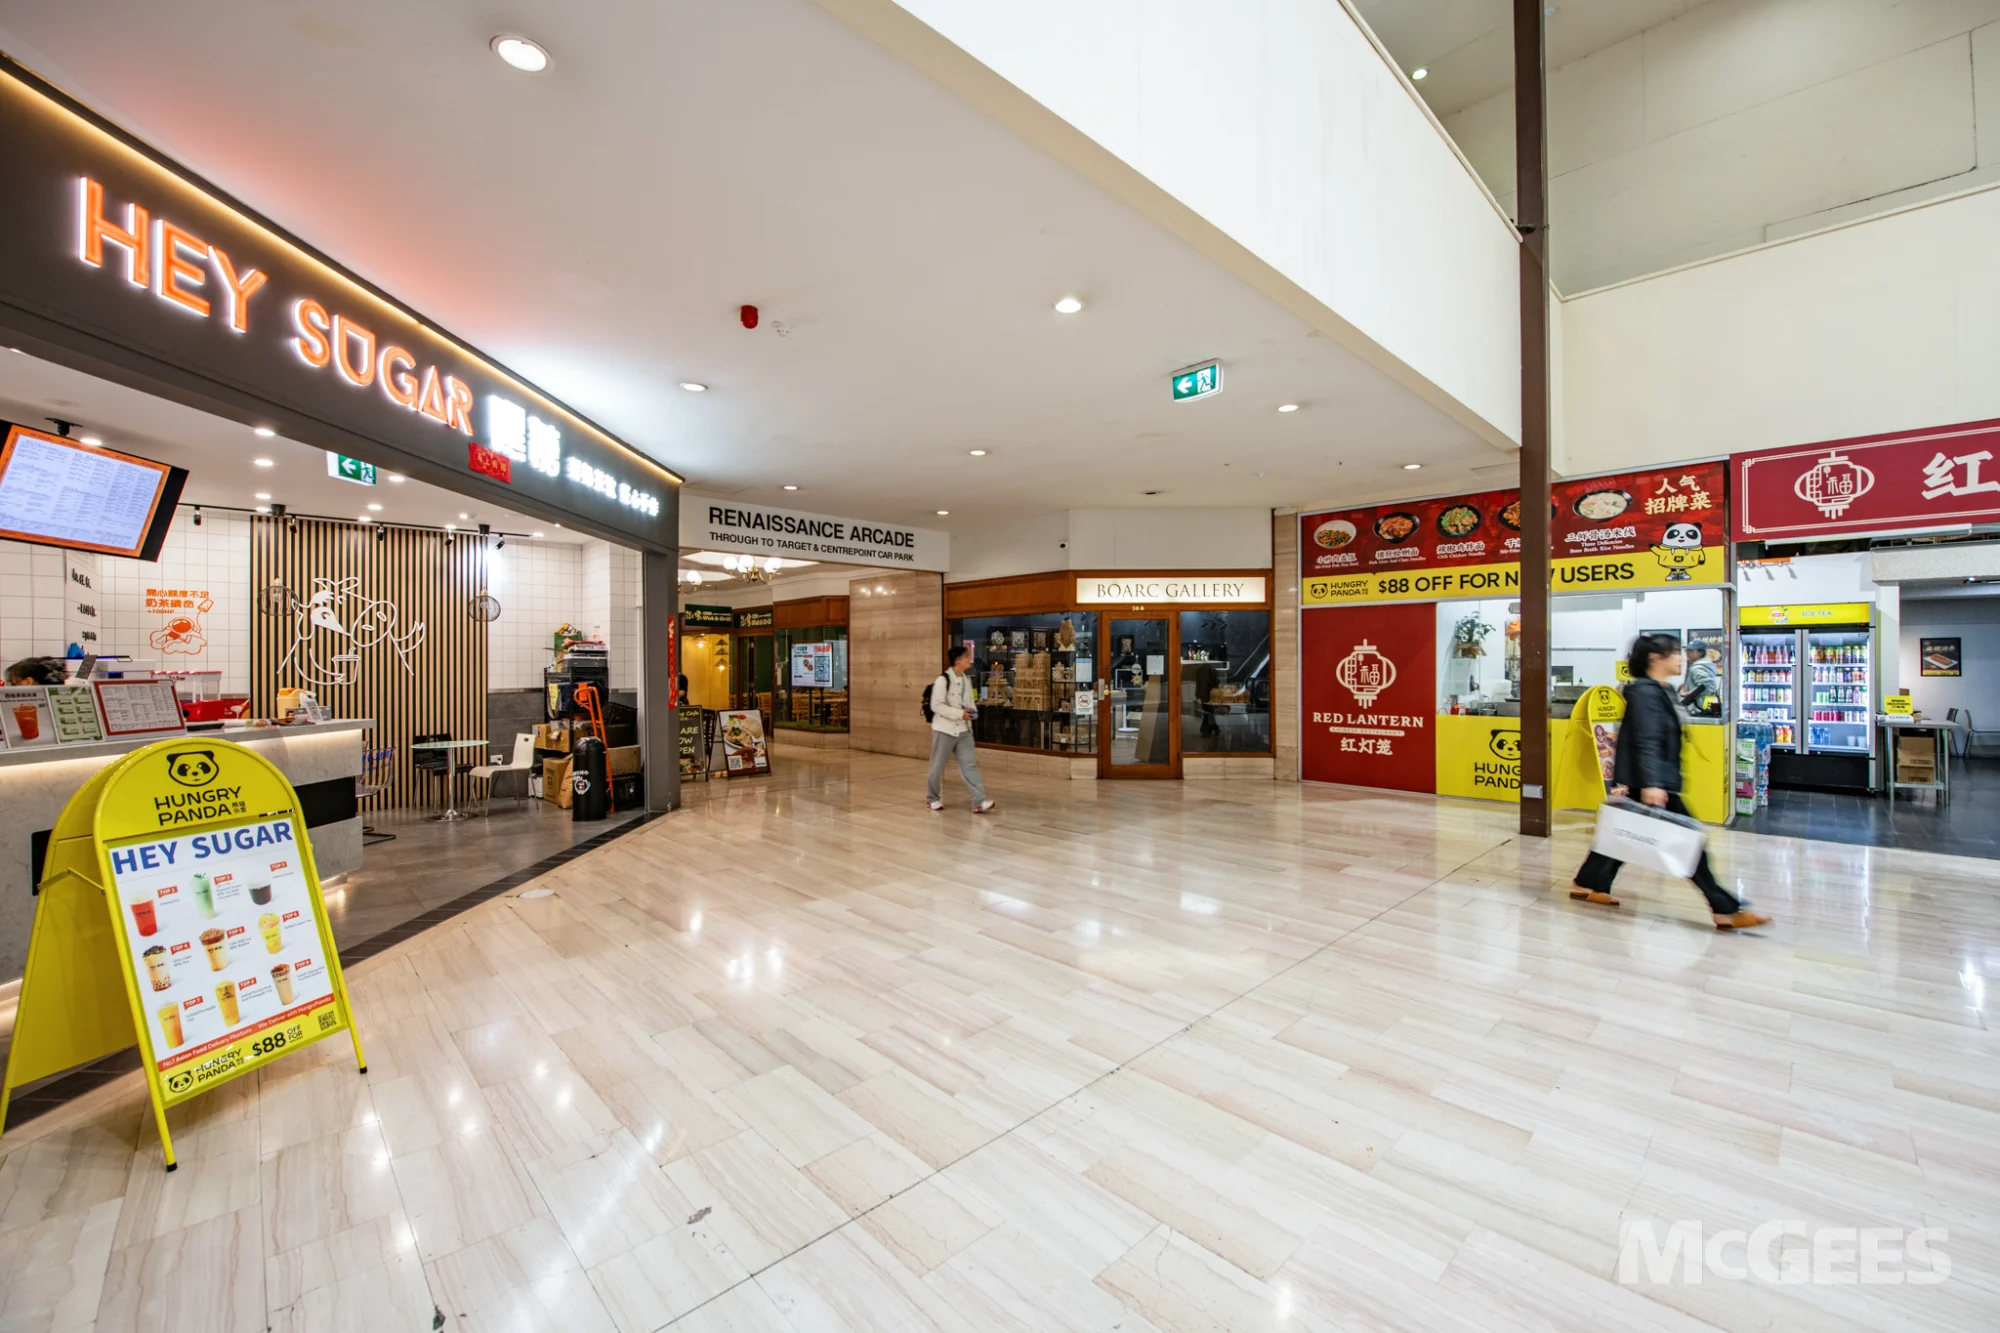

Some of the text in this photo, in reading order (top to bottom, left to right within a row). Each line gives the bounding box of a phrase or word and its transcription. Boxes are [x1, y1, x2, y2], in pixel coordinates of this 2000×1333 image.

[79, 177, 268, 333] HEY
[291, 298, 475, 436] SUGAR
[1655, 475, 1701, 494] 人气
[1921, 450, 2000, 500] 红
[1644, 491, 1713, 515] 招牌菜
[709, 506, 914, 548] RENAISSANCE ARCADE
[709, 532, 914, 562] THROUGH TO TARGET & CENTREPOINT CAR PARK
[1331, 580, 1368, 589] HUNGRY
[1379, 577, 1409, 594] $88
[1415, 575, 1453, 592] OFF
[1460, 572, 1500, 589] FOR
[1561, 562, 1635, 583] USERS
[1097, 583, 1244, 598] BOARC GALLERY
[1331, 589, 1361, 597] PANDA
[1313, 712, 1424, 727] RED LANTERN
[1340, 737, 1393, 755] 红灯笼
[1474, 762, 1521, 776] HUNG
[1474, 775, 1521, 789] PAND
[154, 786, 242, 810] HUNGRY
[158, 803, 232, 826] PANDA
[111, 822, 293, 875] HEY SUGAR
[287, 1024, 301, 1035] OFF
[288, 1031, 303, 1041] FOR
[163, 1058, 176, 1068] No.1
[176, 1052, 192, 1063] Asian
[192, 1046, 207, 1056] Food
[208, 1038, 231, 1052] Delivery
[230, 1028, 252, 1042] Platform
[268, 1014, 286, 1026] Deliver
[252, 1032, 286, 1057] $88
[197, 1062, 236, 1083] PANDA
